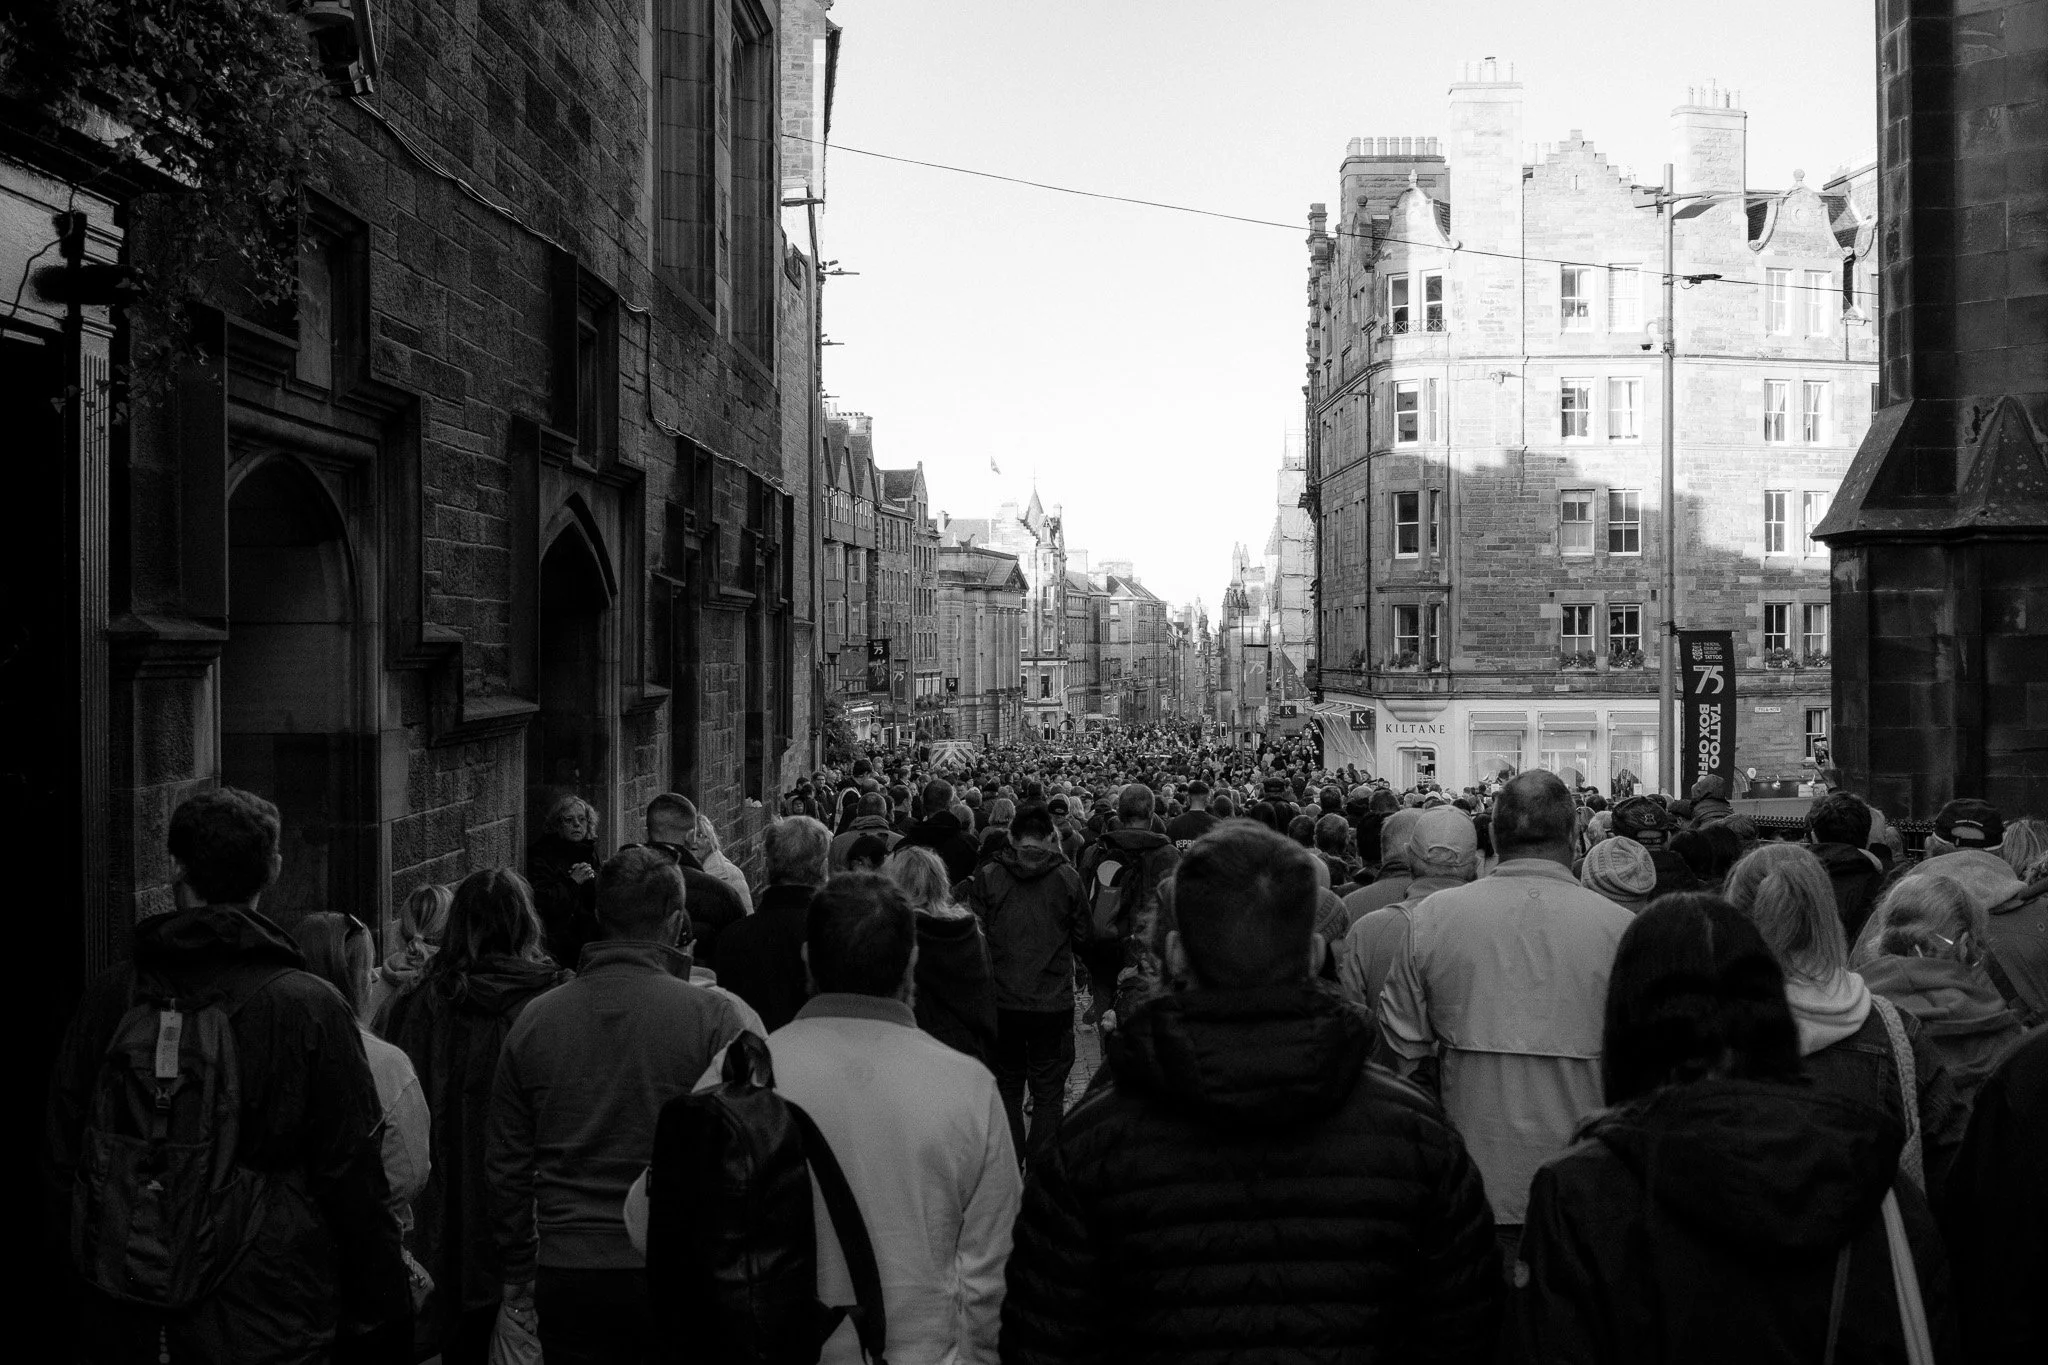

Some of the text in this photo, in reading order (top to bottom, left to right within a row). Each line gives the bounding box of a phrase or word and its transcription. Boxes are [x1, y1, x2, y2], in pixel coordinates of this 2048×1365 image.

[874, 647, 883, 655] 75
[1249, 661, 1265, 674] 75
[893, 671, 904, 682] 75
[1693, 665, 1724, 694] 75
[1285, 707, 1291, 715] K
[1356, 713, 1366, 724] K
[1699, 703, 1710, 738] BOX
[1386, 724, 1446, 734] KILTANE
[1709, 703, 1721, 769] TATTOO
